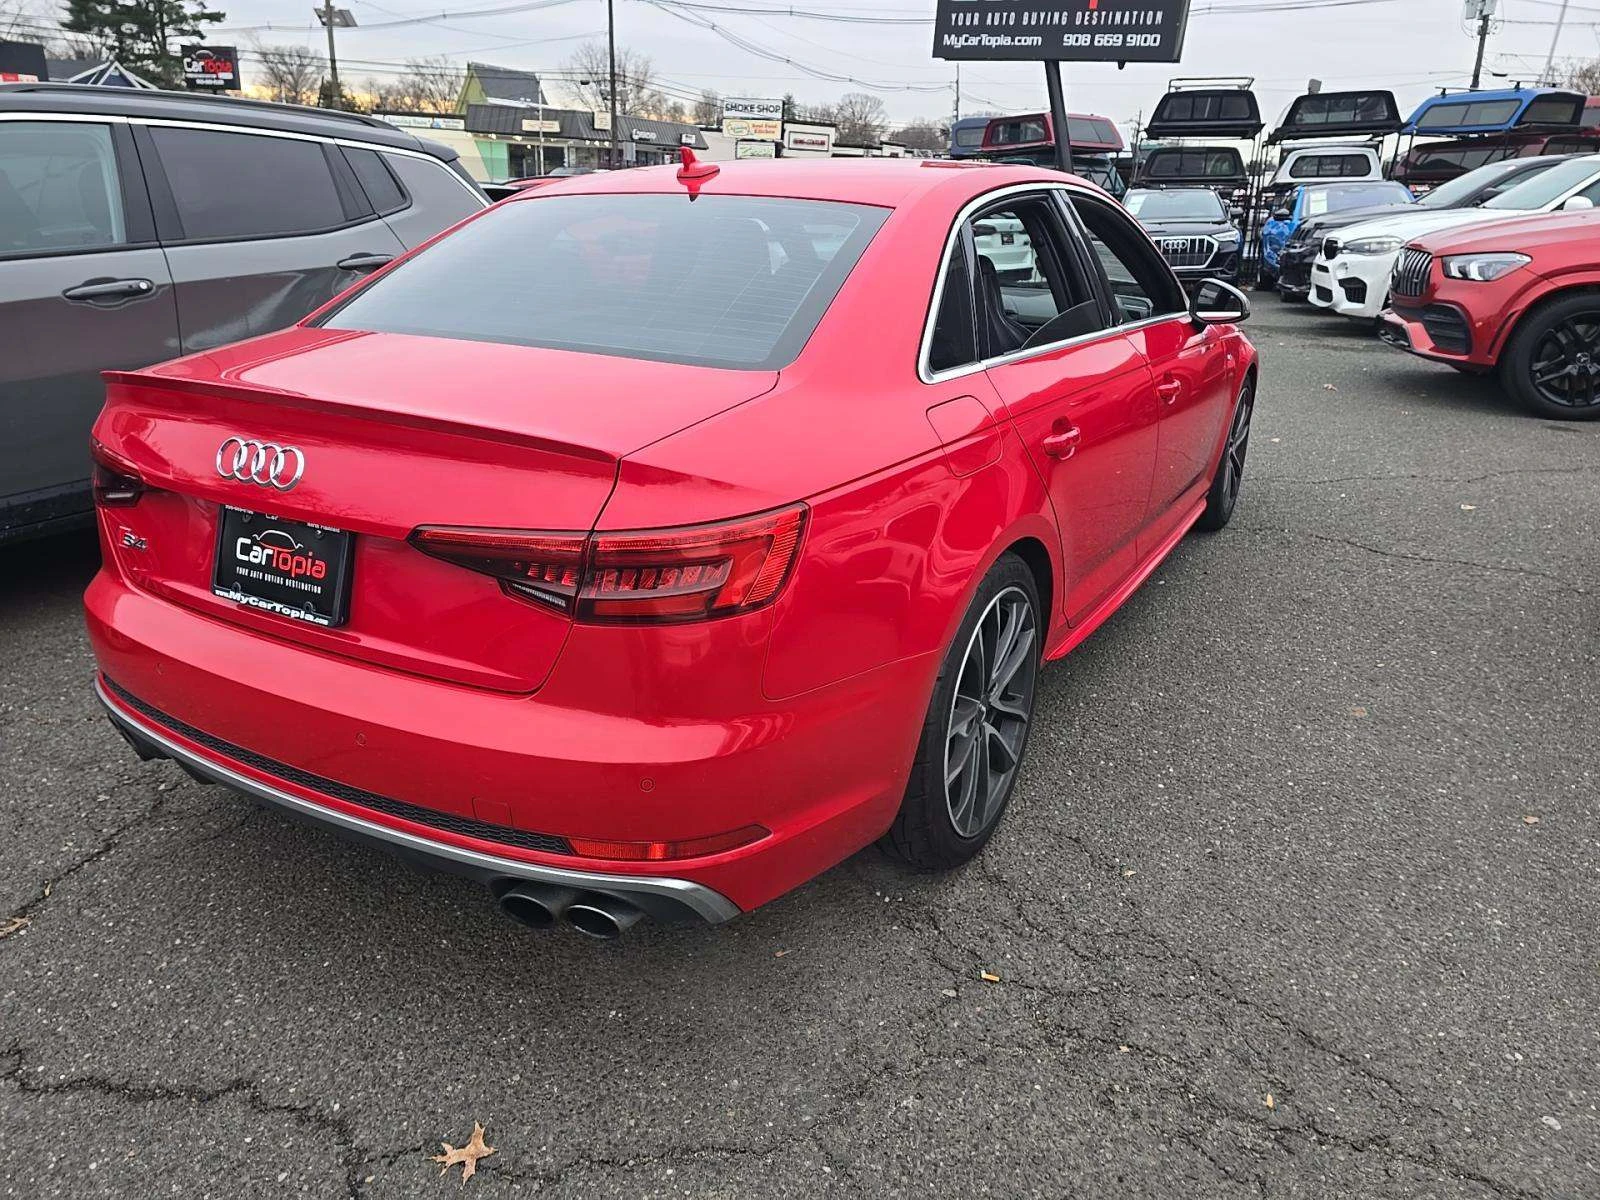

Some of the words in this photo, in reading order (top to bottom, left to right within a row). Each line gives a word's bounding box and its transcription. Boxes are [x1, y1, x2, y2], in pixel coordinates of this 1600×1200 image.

[951, 12, 980, 26] YOUR
[986, 12, 1016, 26] AUTO
[1022, 11, 1068, 26] BUYING
[1075, 10, 1163, 26] DESTINATION
[943, 33, 1042, 48] MyCarTopia.com
[1063, 33, 1091, 47] 908
[1094, 33, 1123, 47] 669
[1126, 33, 1160, 47] 9100
[725, 102, 756, 113] SMOKE
[757, 104, 781, 114] SHOP
[236, 537, 327, 580] CarTopia
